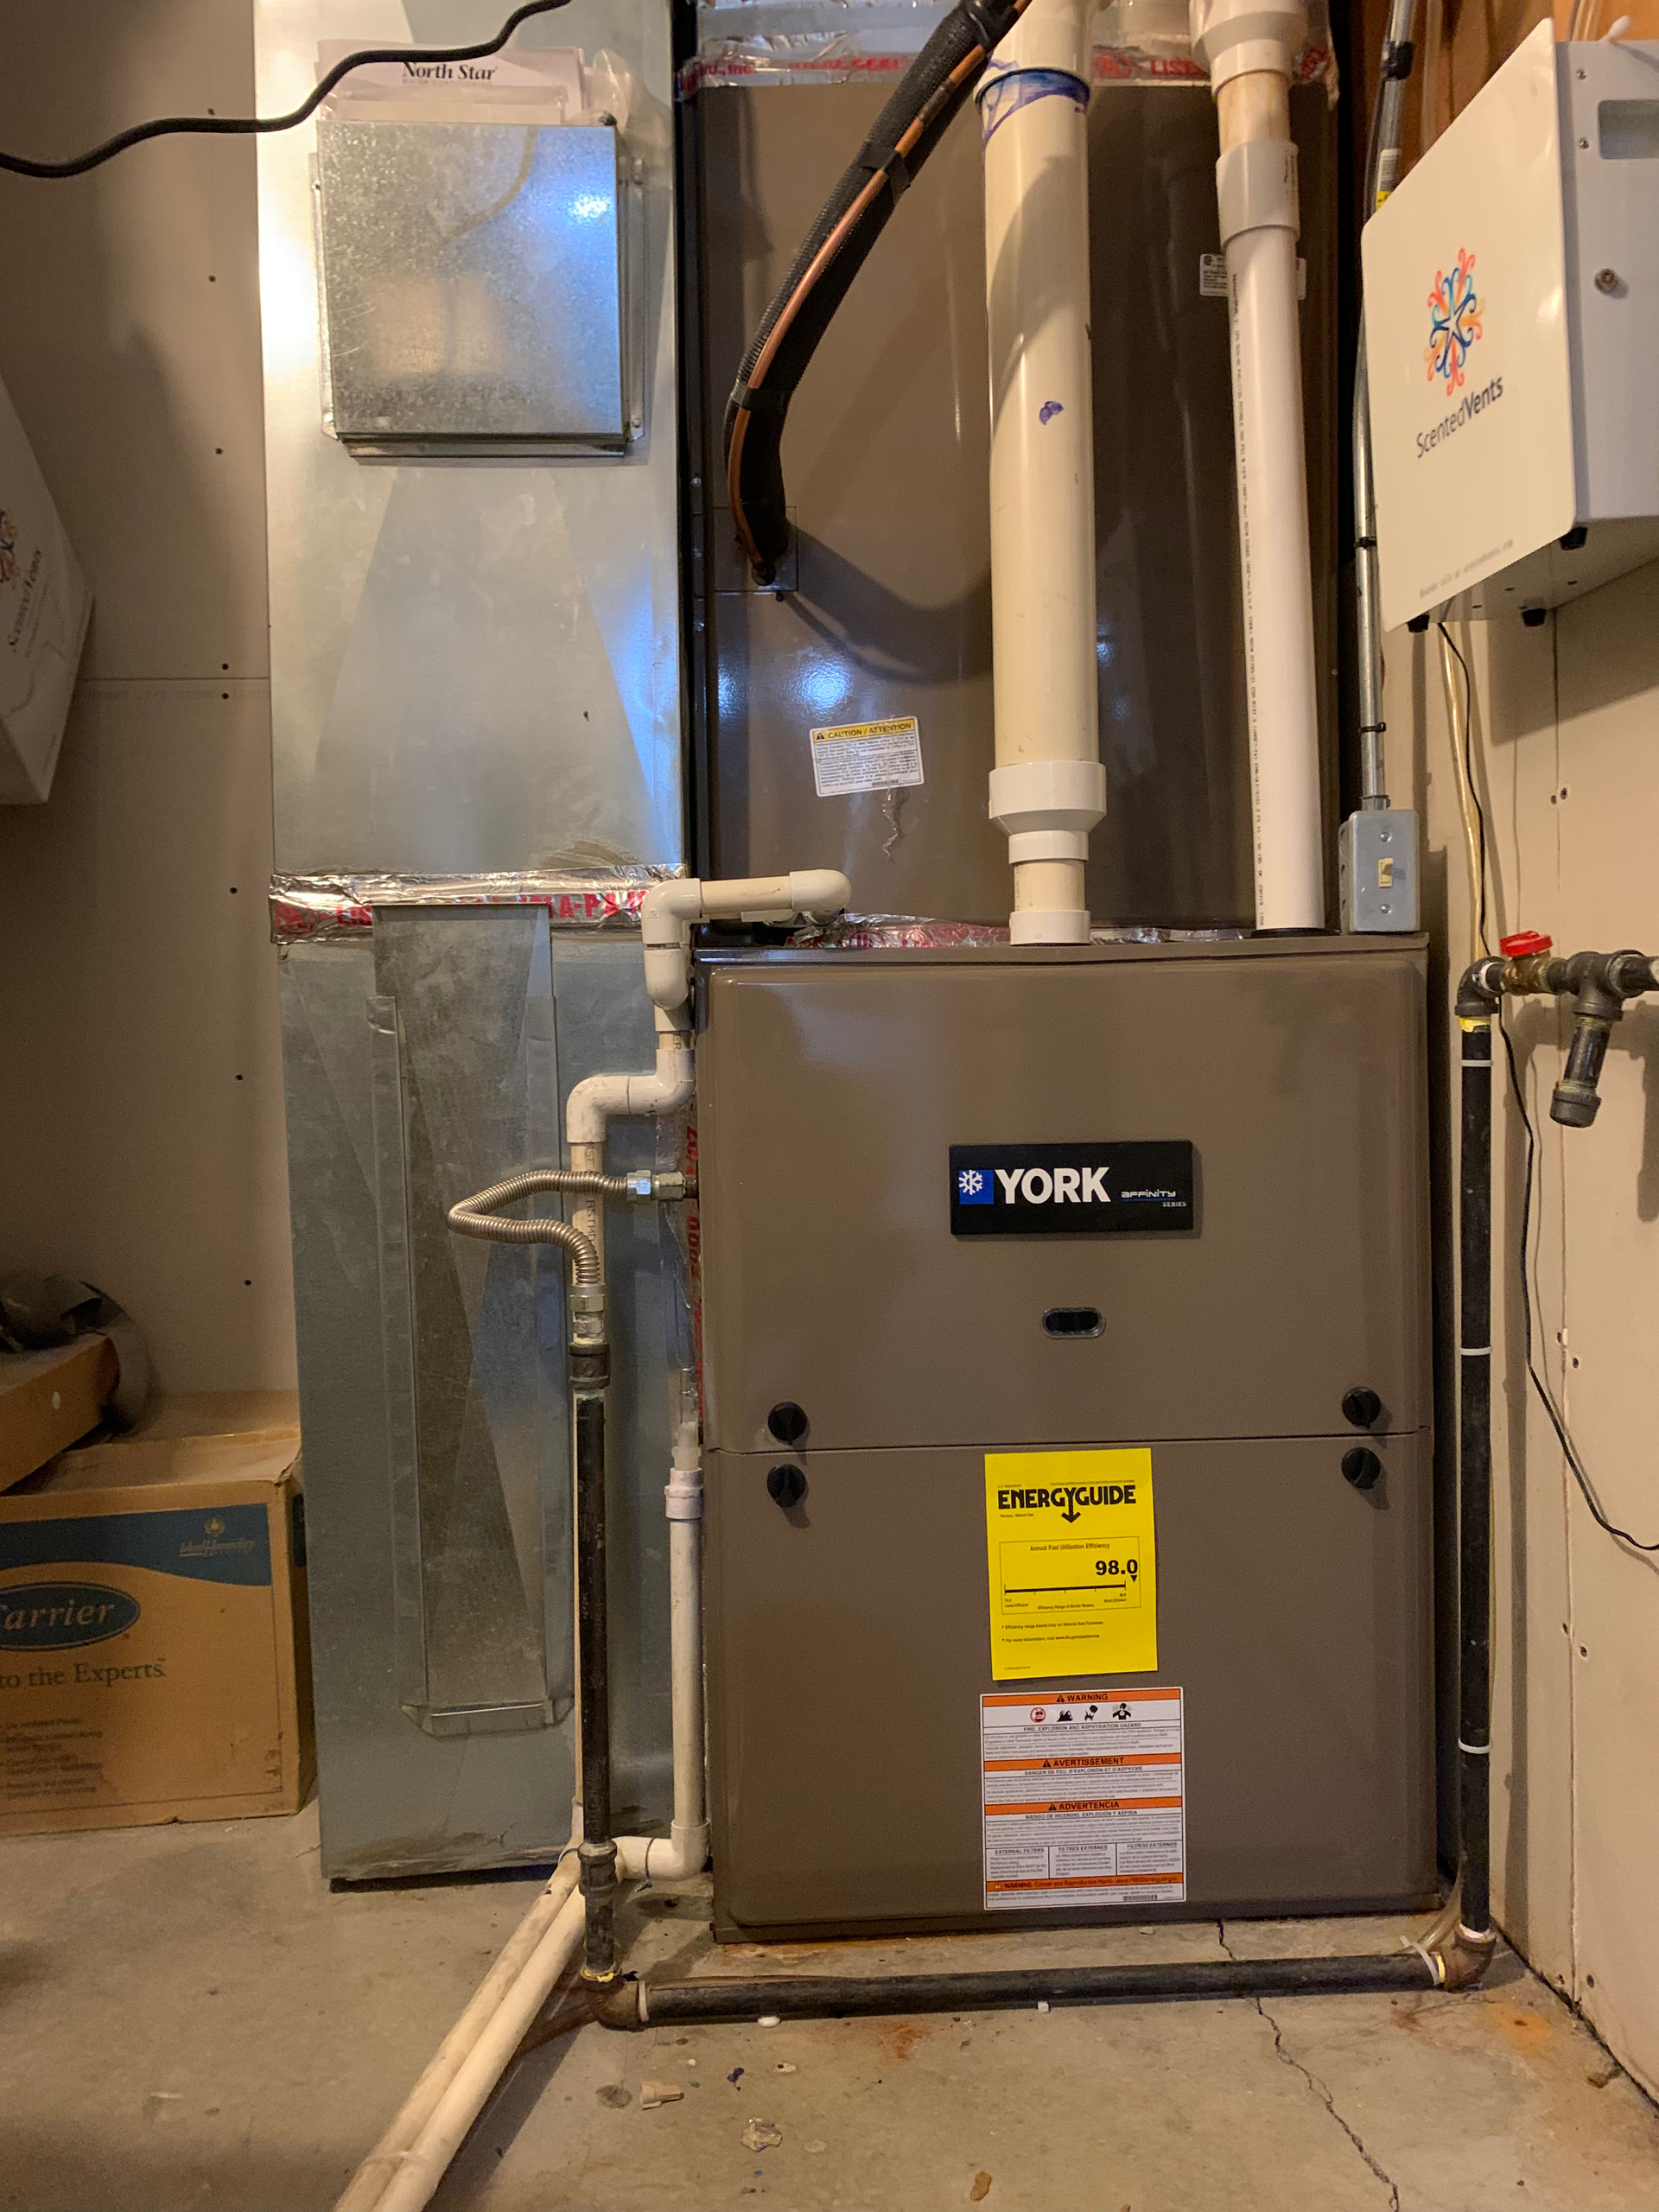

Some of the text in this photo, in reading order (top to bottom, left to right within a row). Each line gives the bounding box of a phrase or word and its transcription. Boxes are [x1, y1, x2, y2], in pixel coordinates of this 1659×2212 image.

[403, 62, 495, 79] North Star
[1415, 376, 1504, 458] ScentedVents
[828, 729, 862, 739] CAUTION
[869, 723, 912, 734] ATTENTION
[995, 1166, 1111, 1205] YORK
[998, 1485, 1136, 1510] ENERGYGUIDE
[1085, 1541, 1110, 1550] Efficiency
[1095, 1559, 1138, 1577] 98.0
[0, 1599, 115, 1631] arrier
[29, 1667, 65, 1688] the
[1067, 1693, 1108, 1702] WARNING
[1053, 1757, 1124, 1768] AVERTISSEMENT
[1059, 1801, 1120, 1810] ADVERTENCIA
